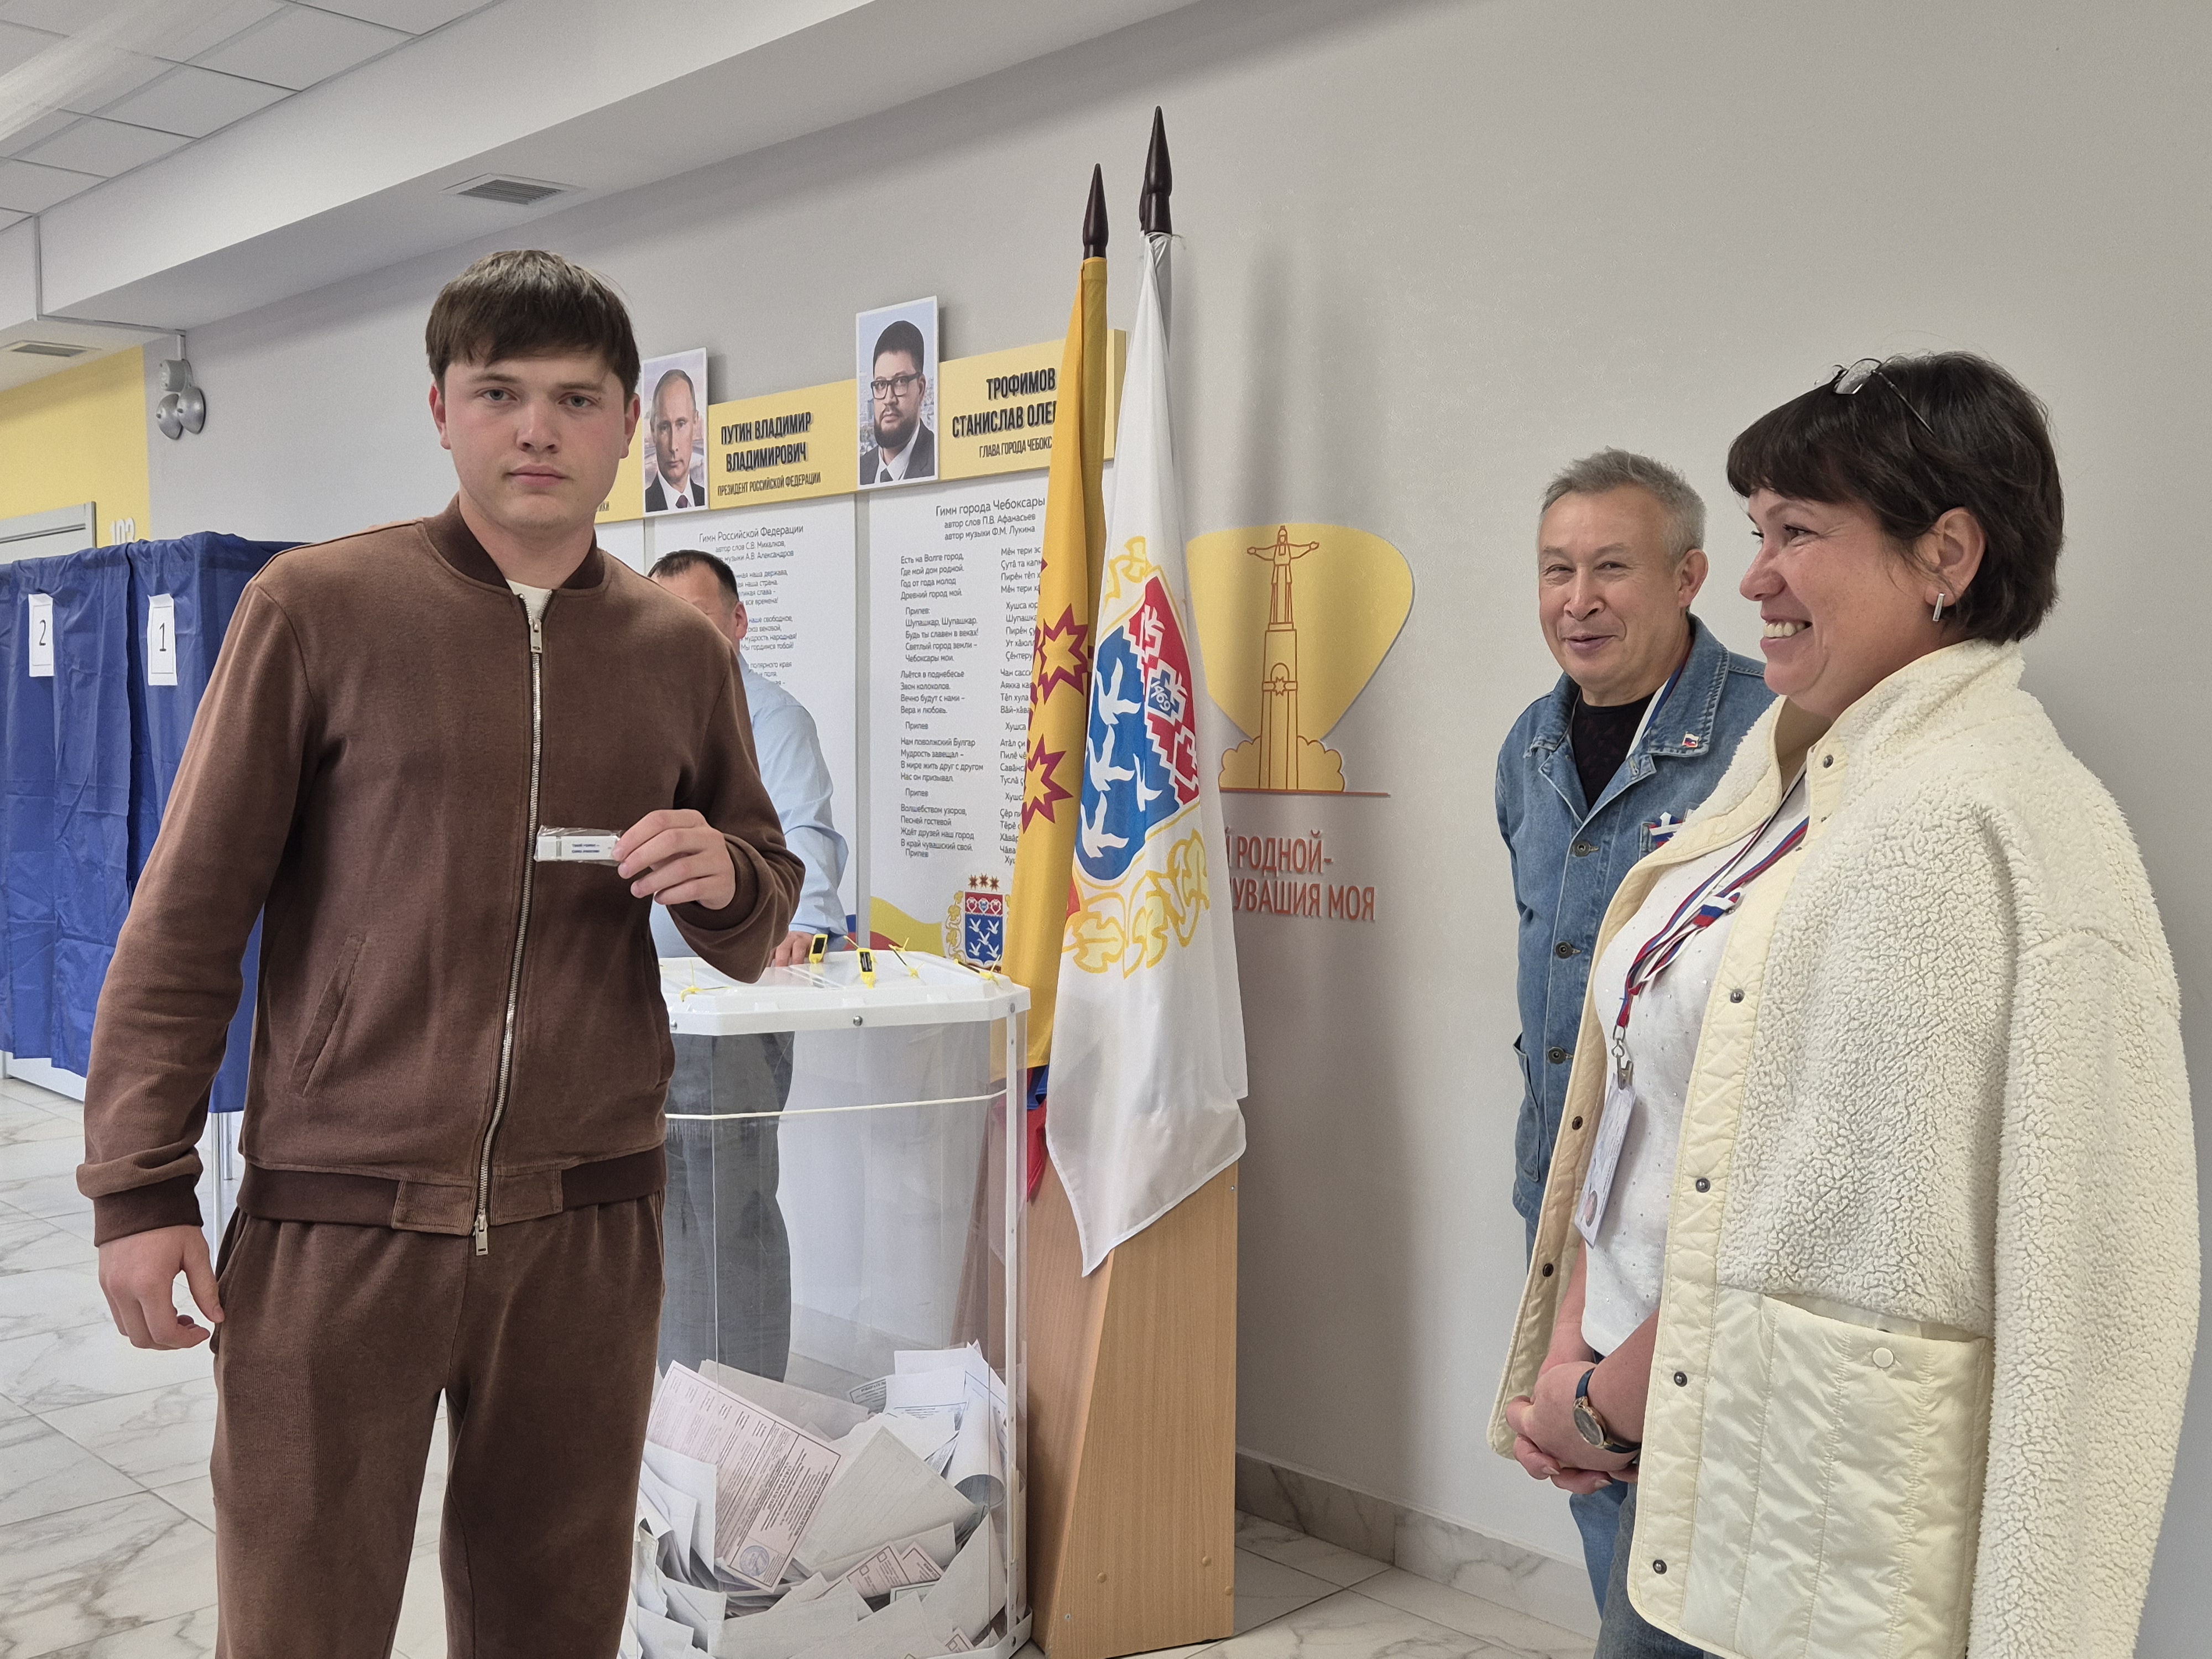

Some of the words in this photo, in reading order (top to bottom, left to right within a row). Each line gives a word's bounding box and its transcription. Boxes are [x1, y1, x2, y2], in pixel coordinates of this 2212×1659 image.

[986, 368, 1056, 400] ТРОФИМОВ
[952, 406, 1024, 437] СТАНИСЛАВ
[721, 422, 752, 445] ПУТИН
[755, 411, 812, 439] ВЛАДИМИР
[979, 443, 1000, 458] ГЛАВА
[1001, 440, 1026, 456] ГОРОДА
[726, 442, 807, 472] ВЛАДИМИРОВИЧ
[718, 482, 748, 496] ПРЕЗИДЕНТ
[749, 475, 784, 492] РОССИЙСКОЙ
[785, 472, 821, 487] ФЕДЕРАЦИИ
[936, 505, 957, 517] Гимн
[959, 503, 991, 516] города
[993, 498, 1045, 510] Чебоксары
[945, 520, 963, 529] автор
[997, 514, 1035, 524] Афанасьев
[699, 533, 716, 543] Гимн
[718, 529, 759, 541] Российской
[760, 525, 804, 538] Федерации
[945, 533, 964, 541] автор
[966, 530, 990, 540] музыки
[1009, 525, 1035, 536] Лукина
[901, 556, 914, 564] Есть
[901, 567, 911, 576] Где
[901, 580, 911, 588] Год
[929, 591, 948, 599] город
[1006, 602, 1027, 612] Хушса
[39, 619, 46, 646] 2
[158, 622, 166, 651] 1
[906, 630, 920, 641] Будь
[906, 642, 931, 650] Светлый
[933, 643, 951, 652] город
[906, 654, 939, 663] Чебоксары
[927, 670, 964, 679] поднебесье
[900, 682, 915, 690] Звон
[920, 694, 938, 704] будут
[901, 706, 916, 715] Вера
[905, 721, 928, 731] Припев
[1005, 722, 1026, 733] Хушса
[953, 738, 975, 748] Булгар
[901, 749, 931, 759] Мудрость
[901, 760, 905, 769] В
[906, 762, 922, 770] мире
[960, 764, 984, 773] другом
[905, 788, 928, 798] Припев
[1005, 792, 1024, 804] Хушс
[901, 804, 942, 813] Волшебством
[918, 830, 940, 838] друзей
[955, 832, 974, 841] город
[907, 840, 921, 849] край
[905, 848, 928, 858] Припев
[1237, 830, 1332, 878] РОДНОЙ-
[1229, 877, 1321, 916] УВАШИЯ
[1328, 884, 1375, 921] МОЯ
